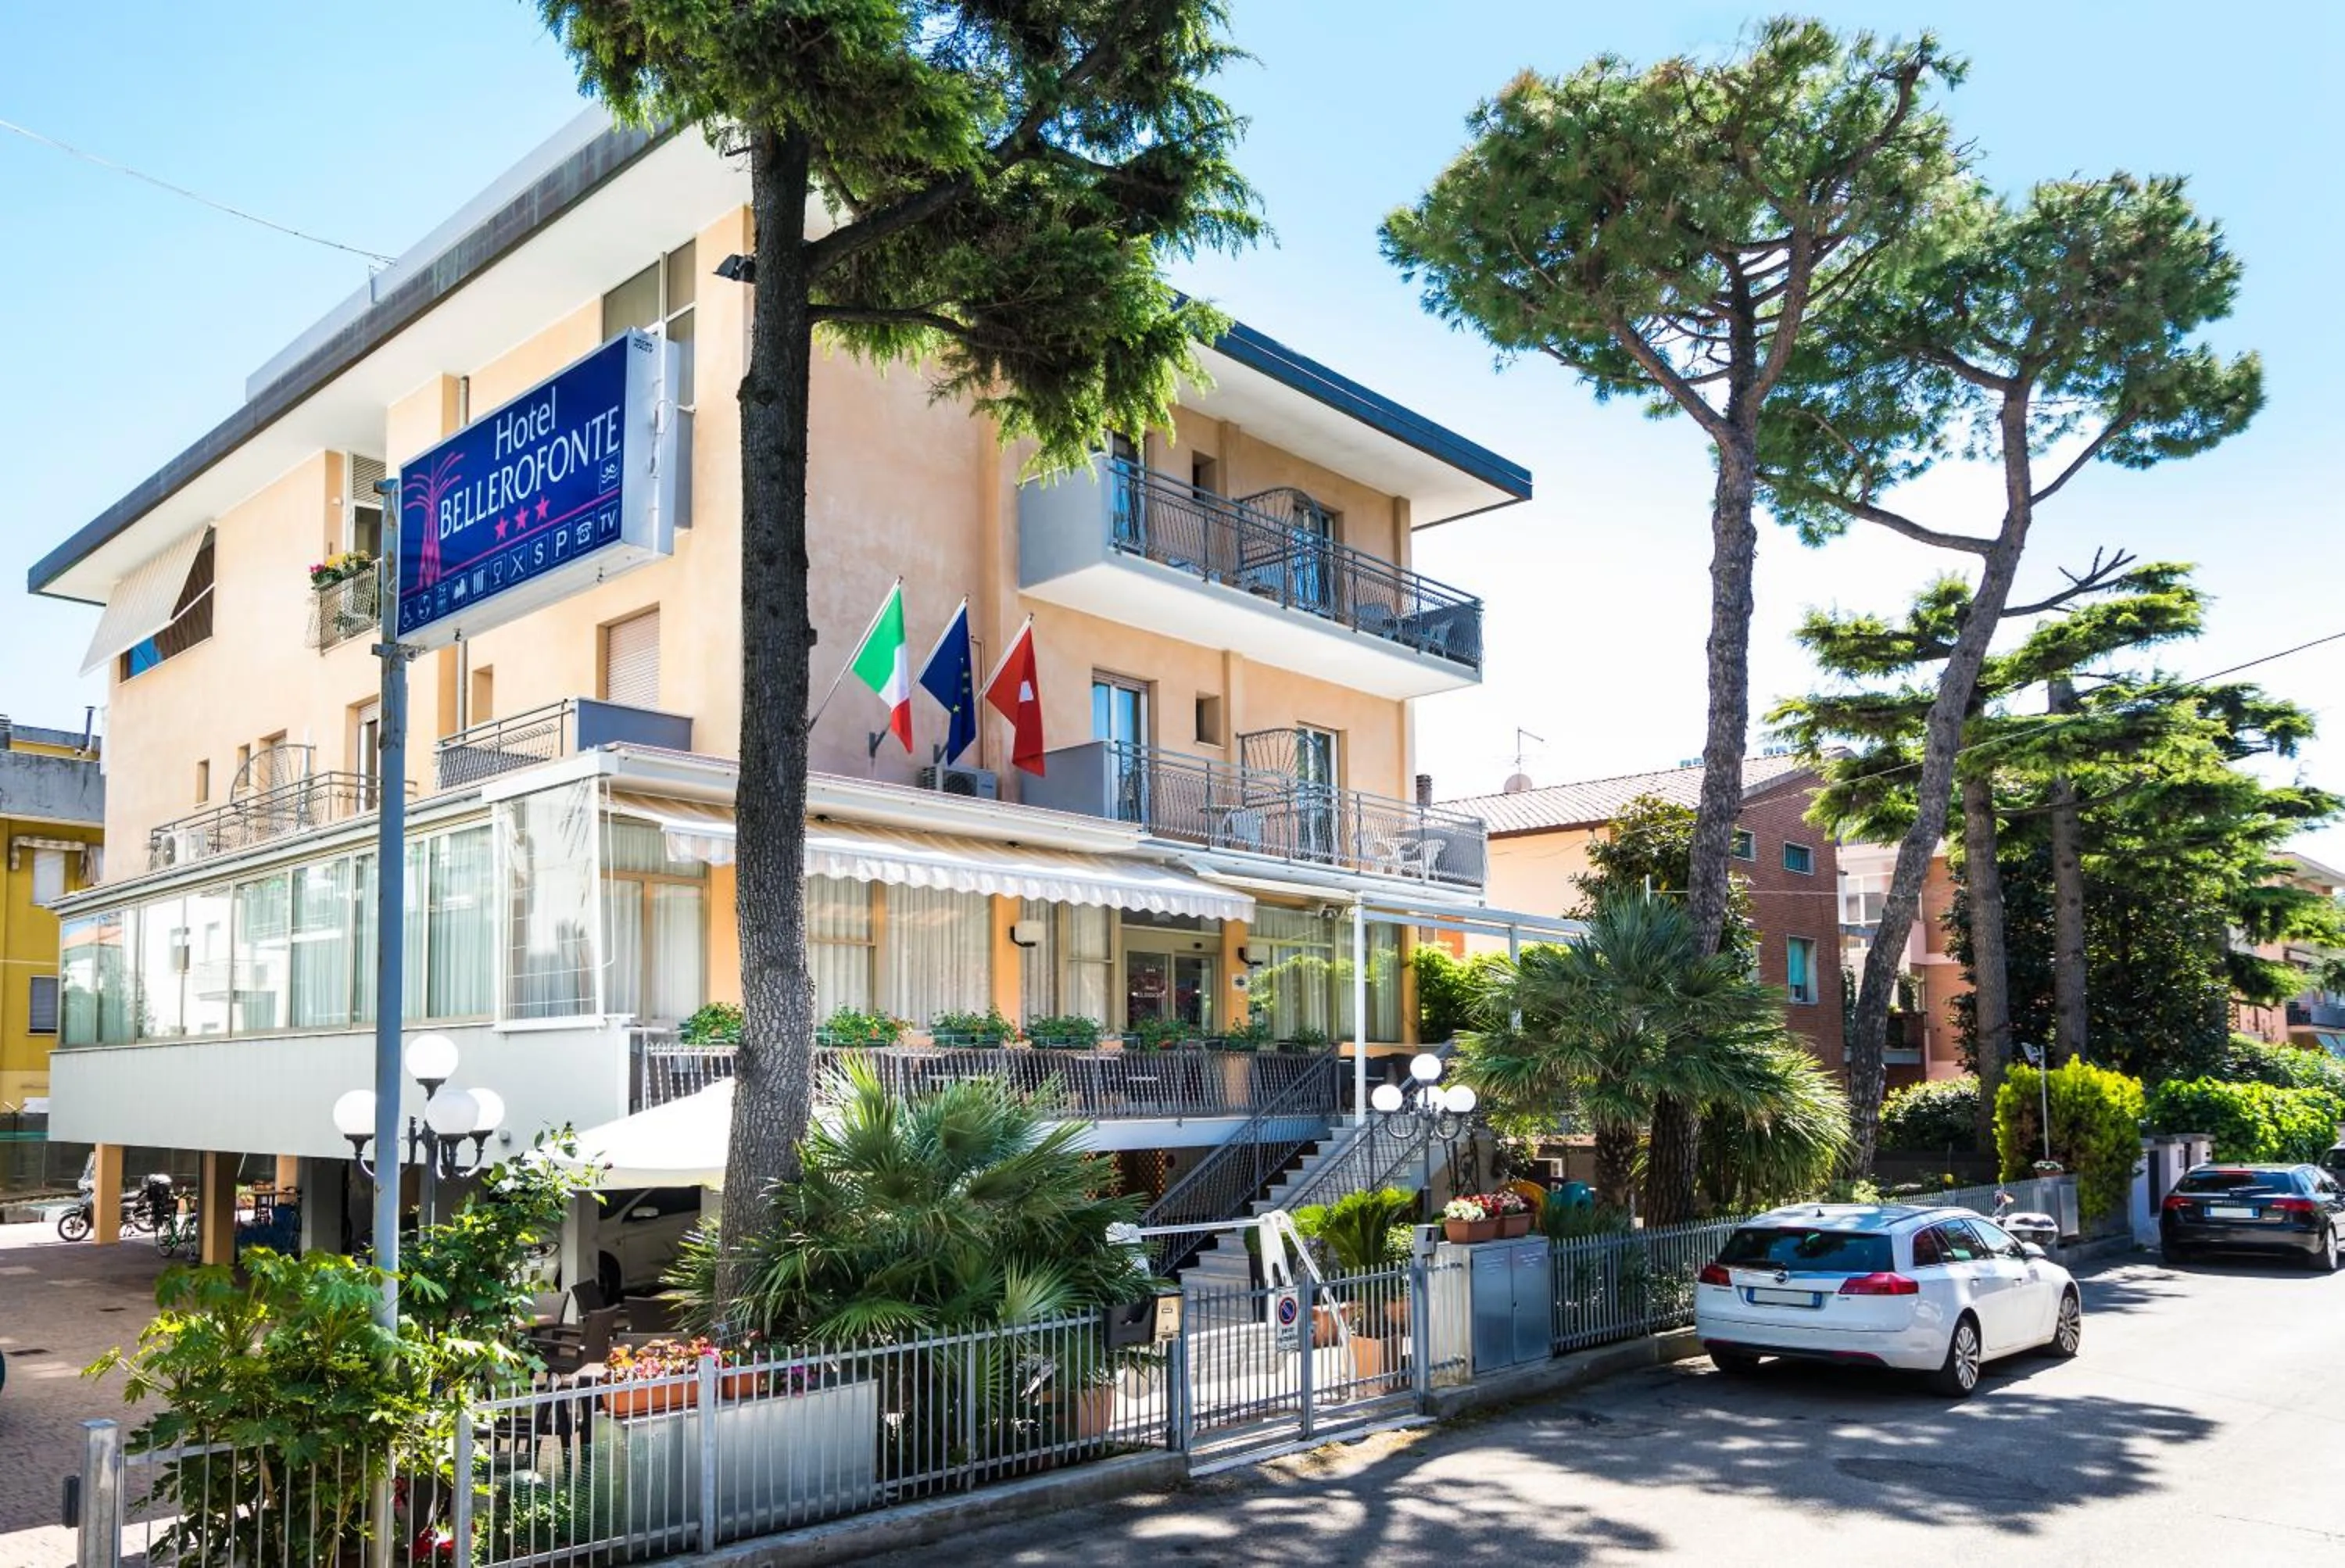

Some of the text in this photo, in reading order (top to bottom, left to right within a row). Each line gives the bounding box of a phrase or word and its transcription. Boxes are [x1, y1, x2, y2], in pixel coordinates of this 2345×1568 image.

[495, 386, 556, 461] Hotel
[439, 406, 620, 540] BELLEROFONTE
[534, 510, 617, 565] S P TV
